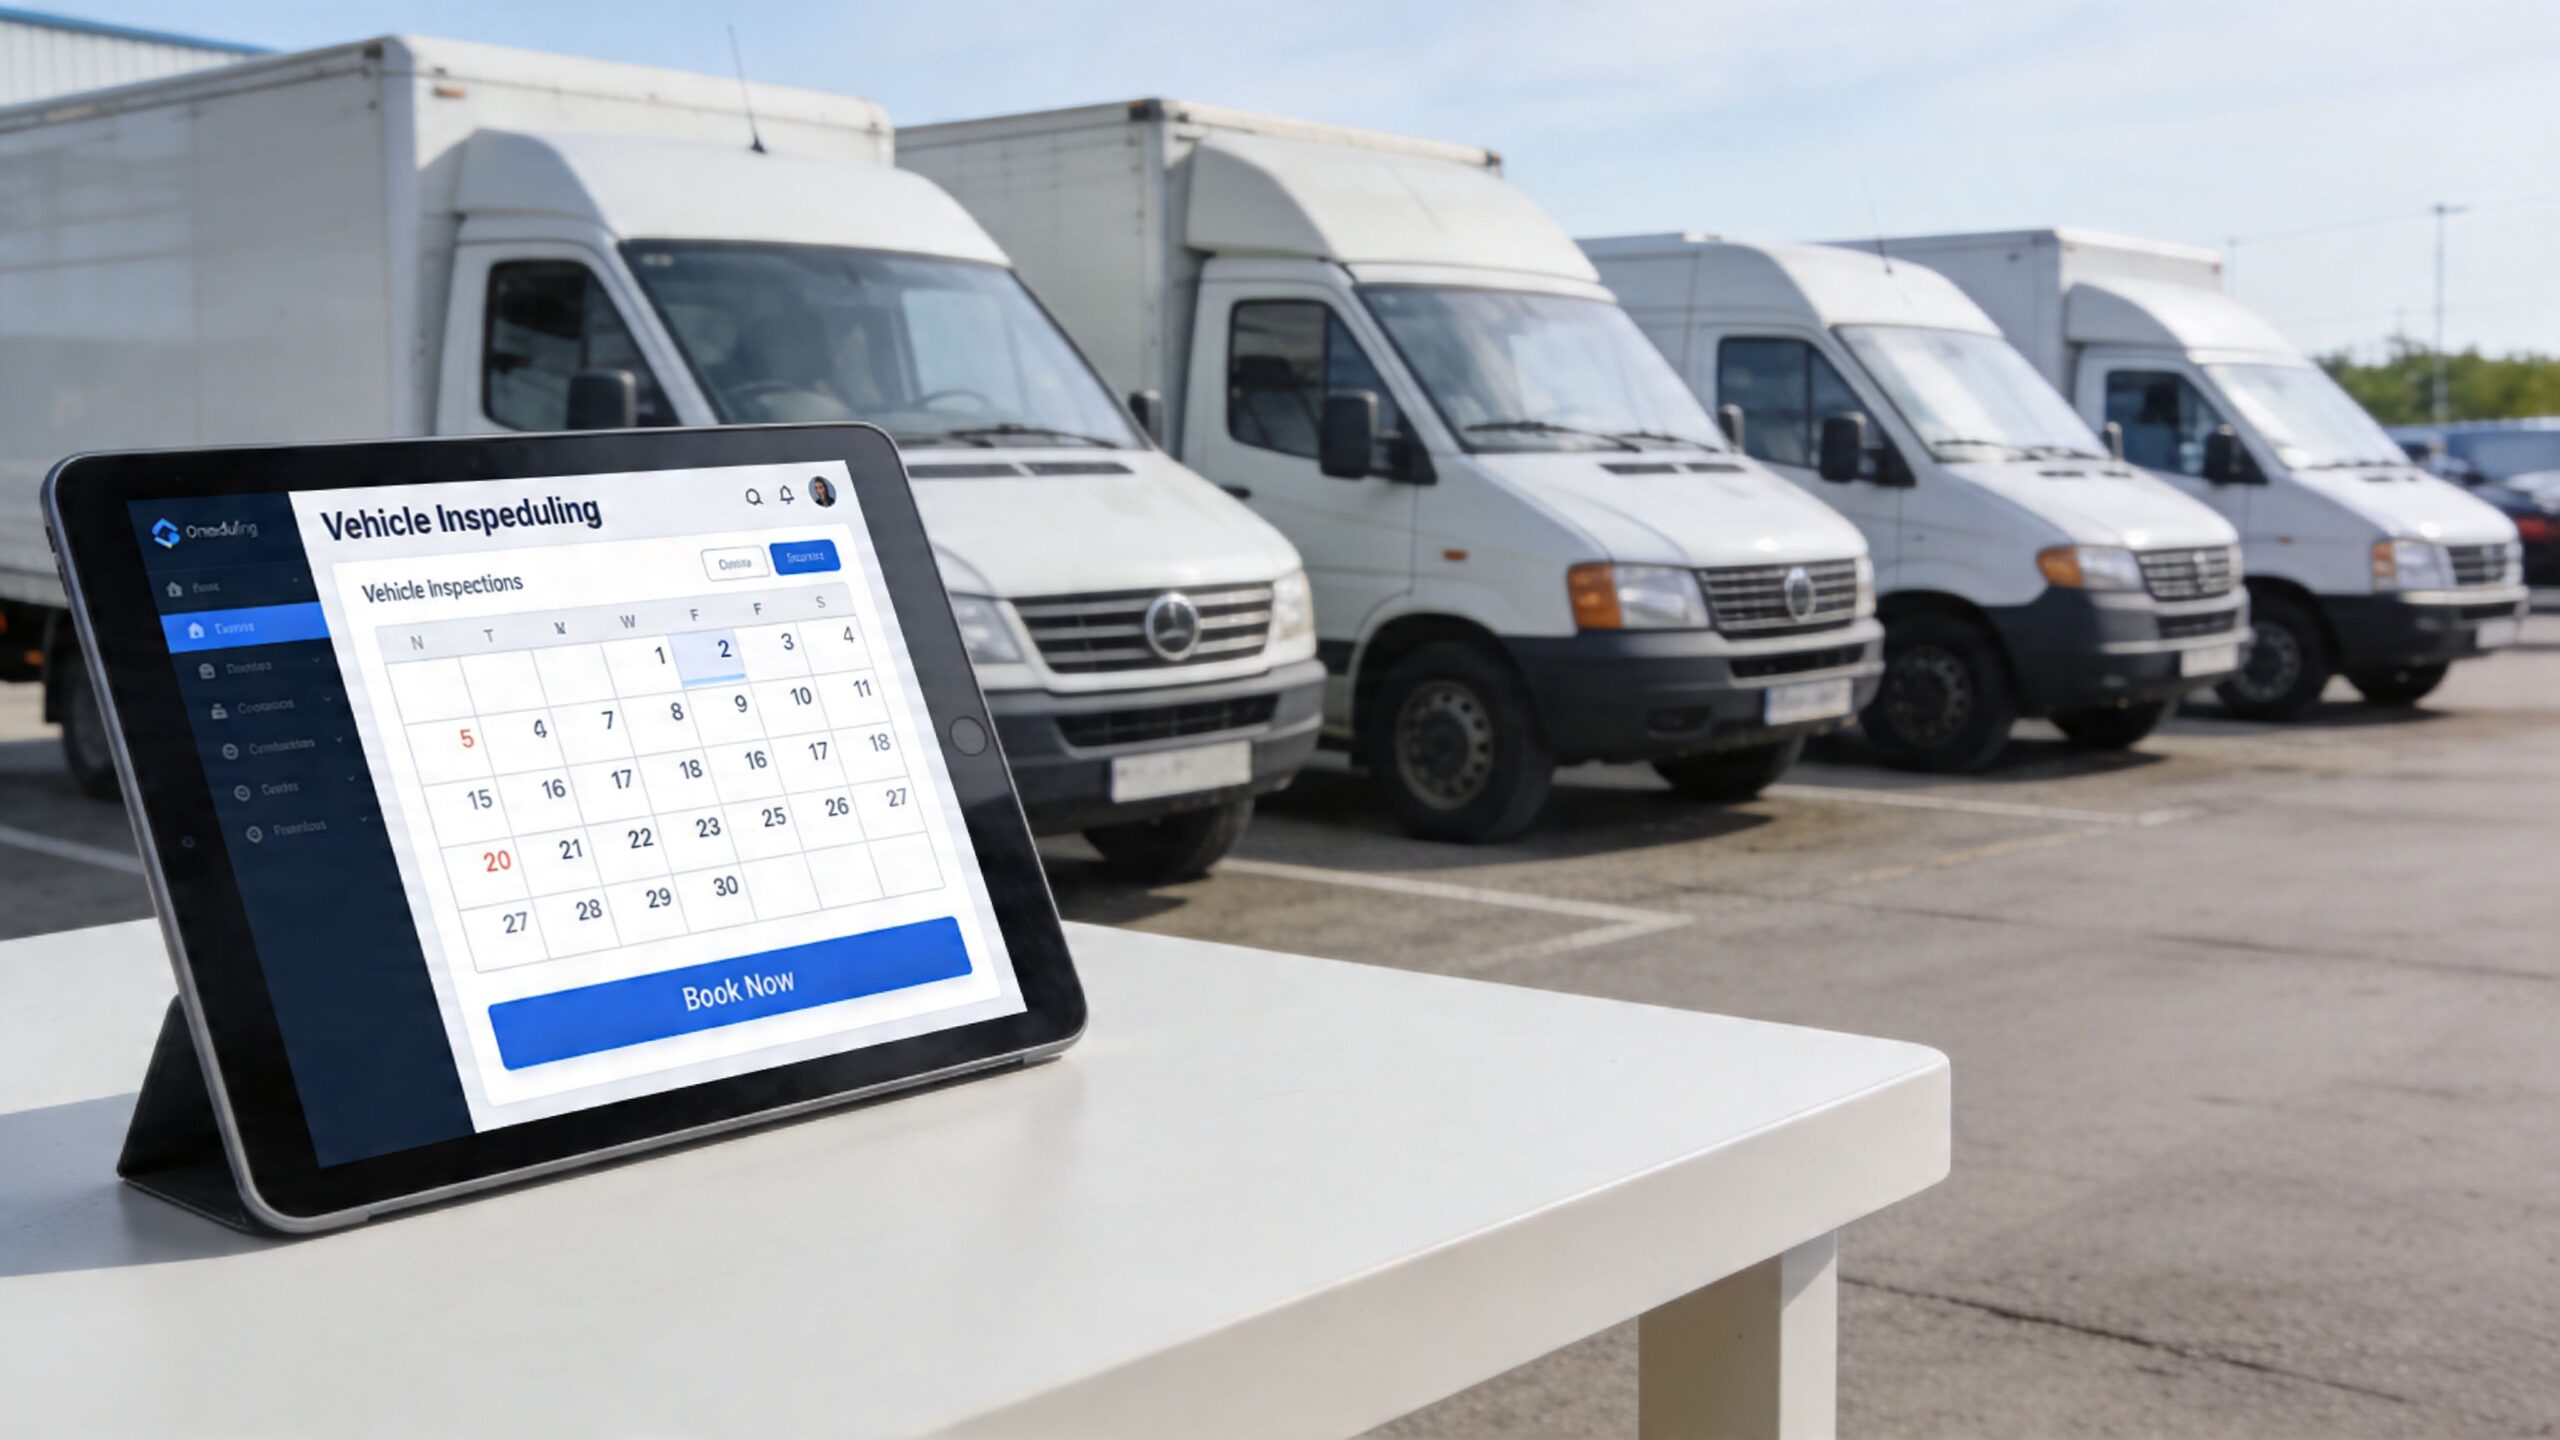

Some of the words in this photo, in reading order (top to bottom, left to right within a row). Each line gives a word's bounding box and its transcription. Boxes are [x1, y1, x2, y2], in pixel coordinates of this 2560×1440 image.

[319, 506, 433, 542] Vehicle
[435, 495, 603, 538] Inspeduling
[361, 579, 426, 603] Vehicle
[409, 634, 426, 651] N
[482, 627, 495, 643] T
[618, 613, 637, 630] W
[688, 607, 700, 623] F
[752, 601, 763, 616] F
[814, 594, 827, 610] S
[654, 645, 667, 666] 1
[716, 638, 733, 659] 2
[779, 631, 796, 652] 3
[842, 625, 856, 644] 4
[458, 728, 476, 750] 5
[600, 709, 615, 731] 7
[669, 701, 685, 722] 8
[733, 693, 749, 714] 9
[789, 685, 813, 707] 10
[852, 678, 873, 699] 11
[466, 787, 494, 811] 15
[540, 777, 568, 801] 16
[610, 767, 633, 791] 17
[678, 758, 704, 781] 18
[744, 749, 769, 771] 16
[807, 740, 829, 762] 17
[868, 731, 892, 753] 18
[482, 849, 513, 874] 20
[558, 837, 584, 861] 21
[626, 826, 655, 850] 22
[694, 816, 722, 839] 23
[760, 805, 787, 829] 25
[824, 795, 851, 818] 26
[884, 786, 908, 809] 27
[501, 910, 529, 935] 27
[574, 897, 604, 922] 28
[644, 886, 673, 910] 29
[712, 874, 740, 898] 30
[682, 978, 743, 1011] Book
[744, 971, 795, 999] Now
